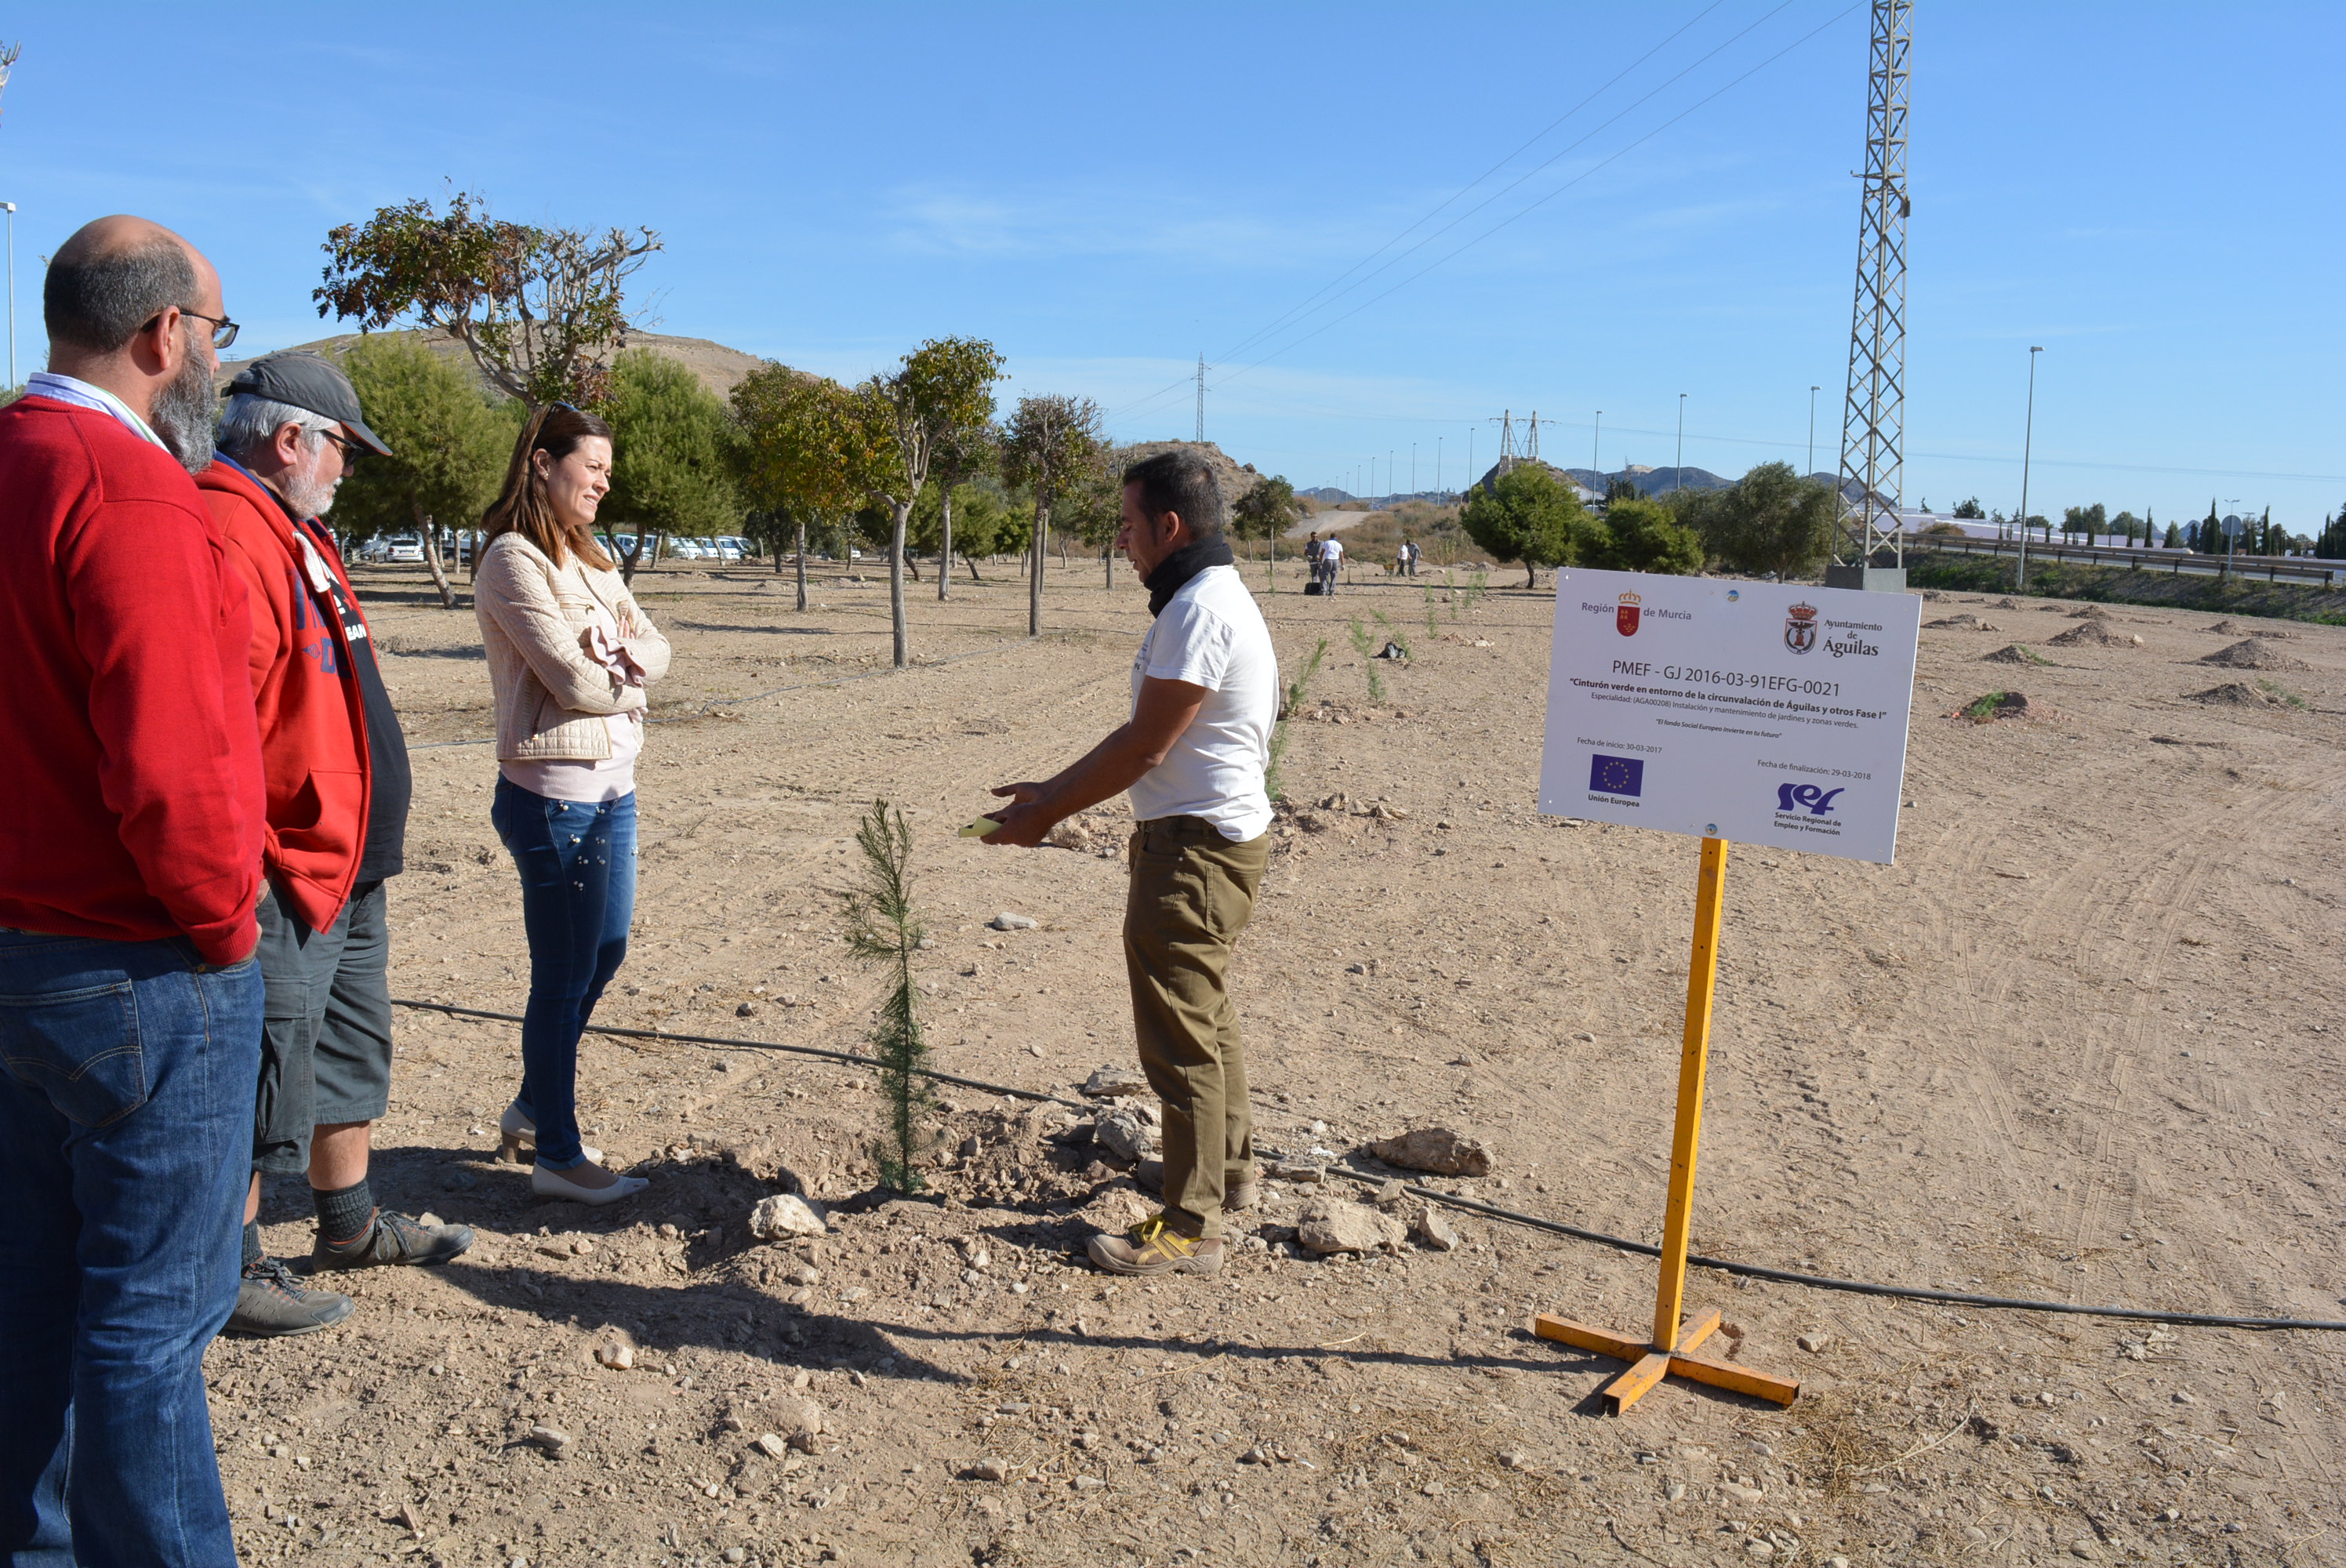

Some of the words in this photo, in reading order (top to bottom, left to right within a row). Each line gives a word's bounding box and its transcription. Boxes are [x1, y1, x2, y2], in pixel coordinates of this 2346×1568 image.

[1582, 602, 1614, 614] Región
[1643, 608, 1655, 617] de
[1658, 609, 1691, 620] Murcia
[1825, 619, 1883, 631] Ayuntamiento
[1847, 631, 1858, 640] de
[1823, 637, 1879, 658] Águilas
[1612, 660, 1651, 677] PMEF
[1664, 666, 1681, 680] GJ
[1685, 668, 1839, 696] 2016-03-91EFG-0021
[1611, 684, 1635, 692] verde
[1649, 688, 1683, 698] entorno
[1685, 690, 1696, 699] de
[1698, 691, 1705, 700] la
[1707, 693, 1770, 708] circunvalación
[1774, 699, 1785, 709] de
[1787, 700, 1820, 713] Águilas
[1829, 707, 1854, 717] otros
[1856, 709, 1876, 718] Fase
[1591, 692, 1632, 703] Especialidad:
[1672, 702, 1707, 712] Instalación
[1715, 706, 1767, 718] mantenimiento
[1777, 713, 1805, 723] jardines
[1834, 720, 1859, 729] verdes.
[1663, 719, 1681, 728] fondo
[1699, 724, 1723, 733] Europeo
[1577, 737, 1596, 746] Fecha
[1606, 740, 1625, 749] inicio:
[1626, 743, 1662, 753] 30-03-2017
[1757, 759, 1778, 768] Fecha
[1789, 764, 1830, 775] finalización:
[1832, 769, 1872, 780] 29-03-2018
[1588, 793, 1609, 804] Unión
[1611, 797, 1640, 808] Europea
[1775, 811, 1801, 822] Servicio
[1803, 815, 1832, 826] Regional
[1774, 821, 1799, 830] Empleo
[1805, 825, 1841, 836] Formación
